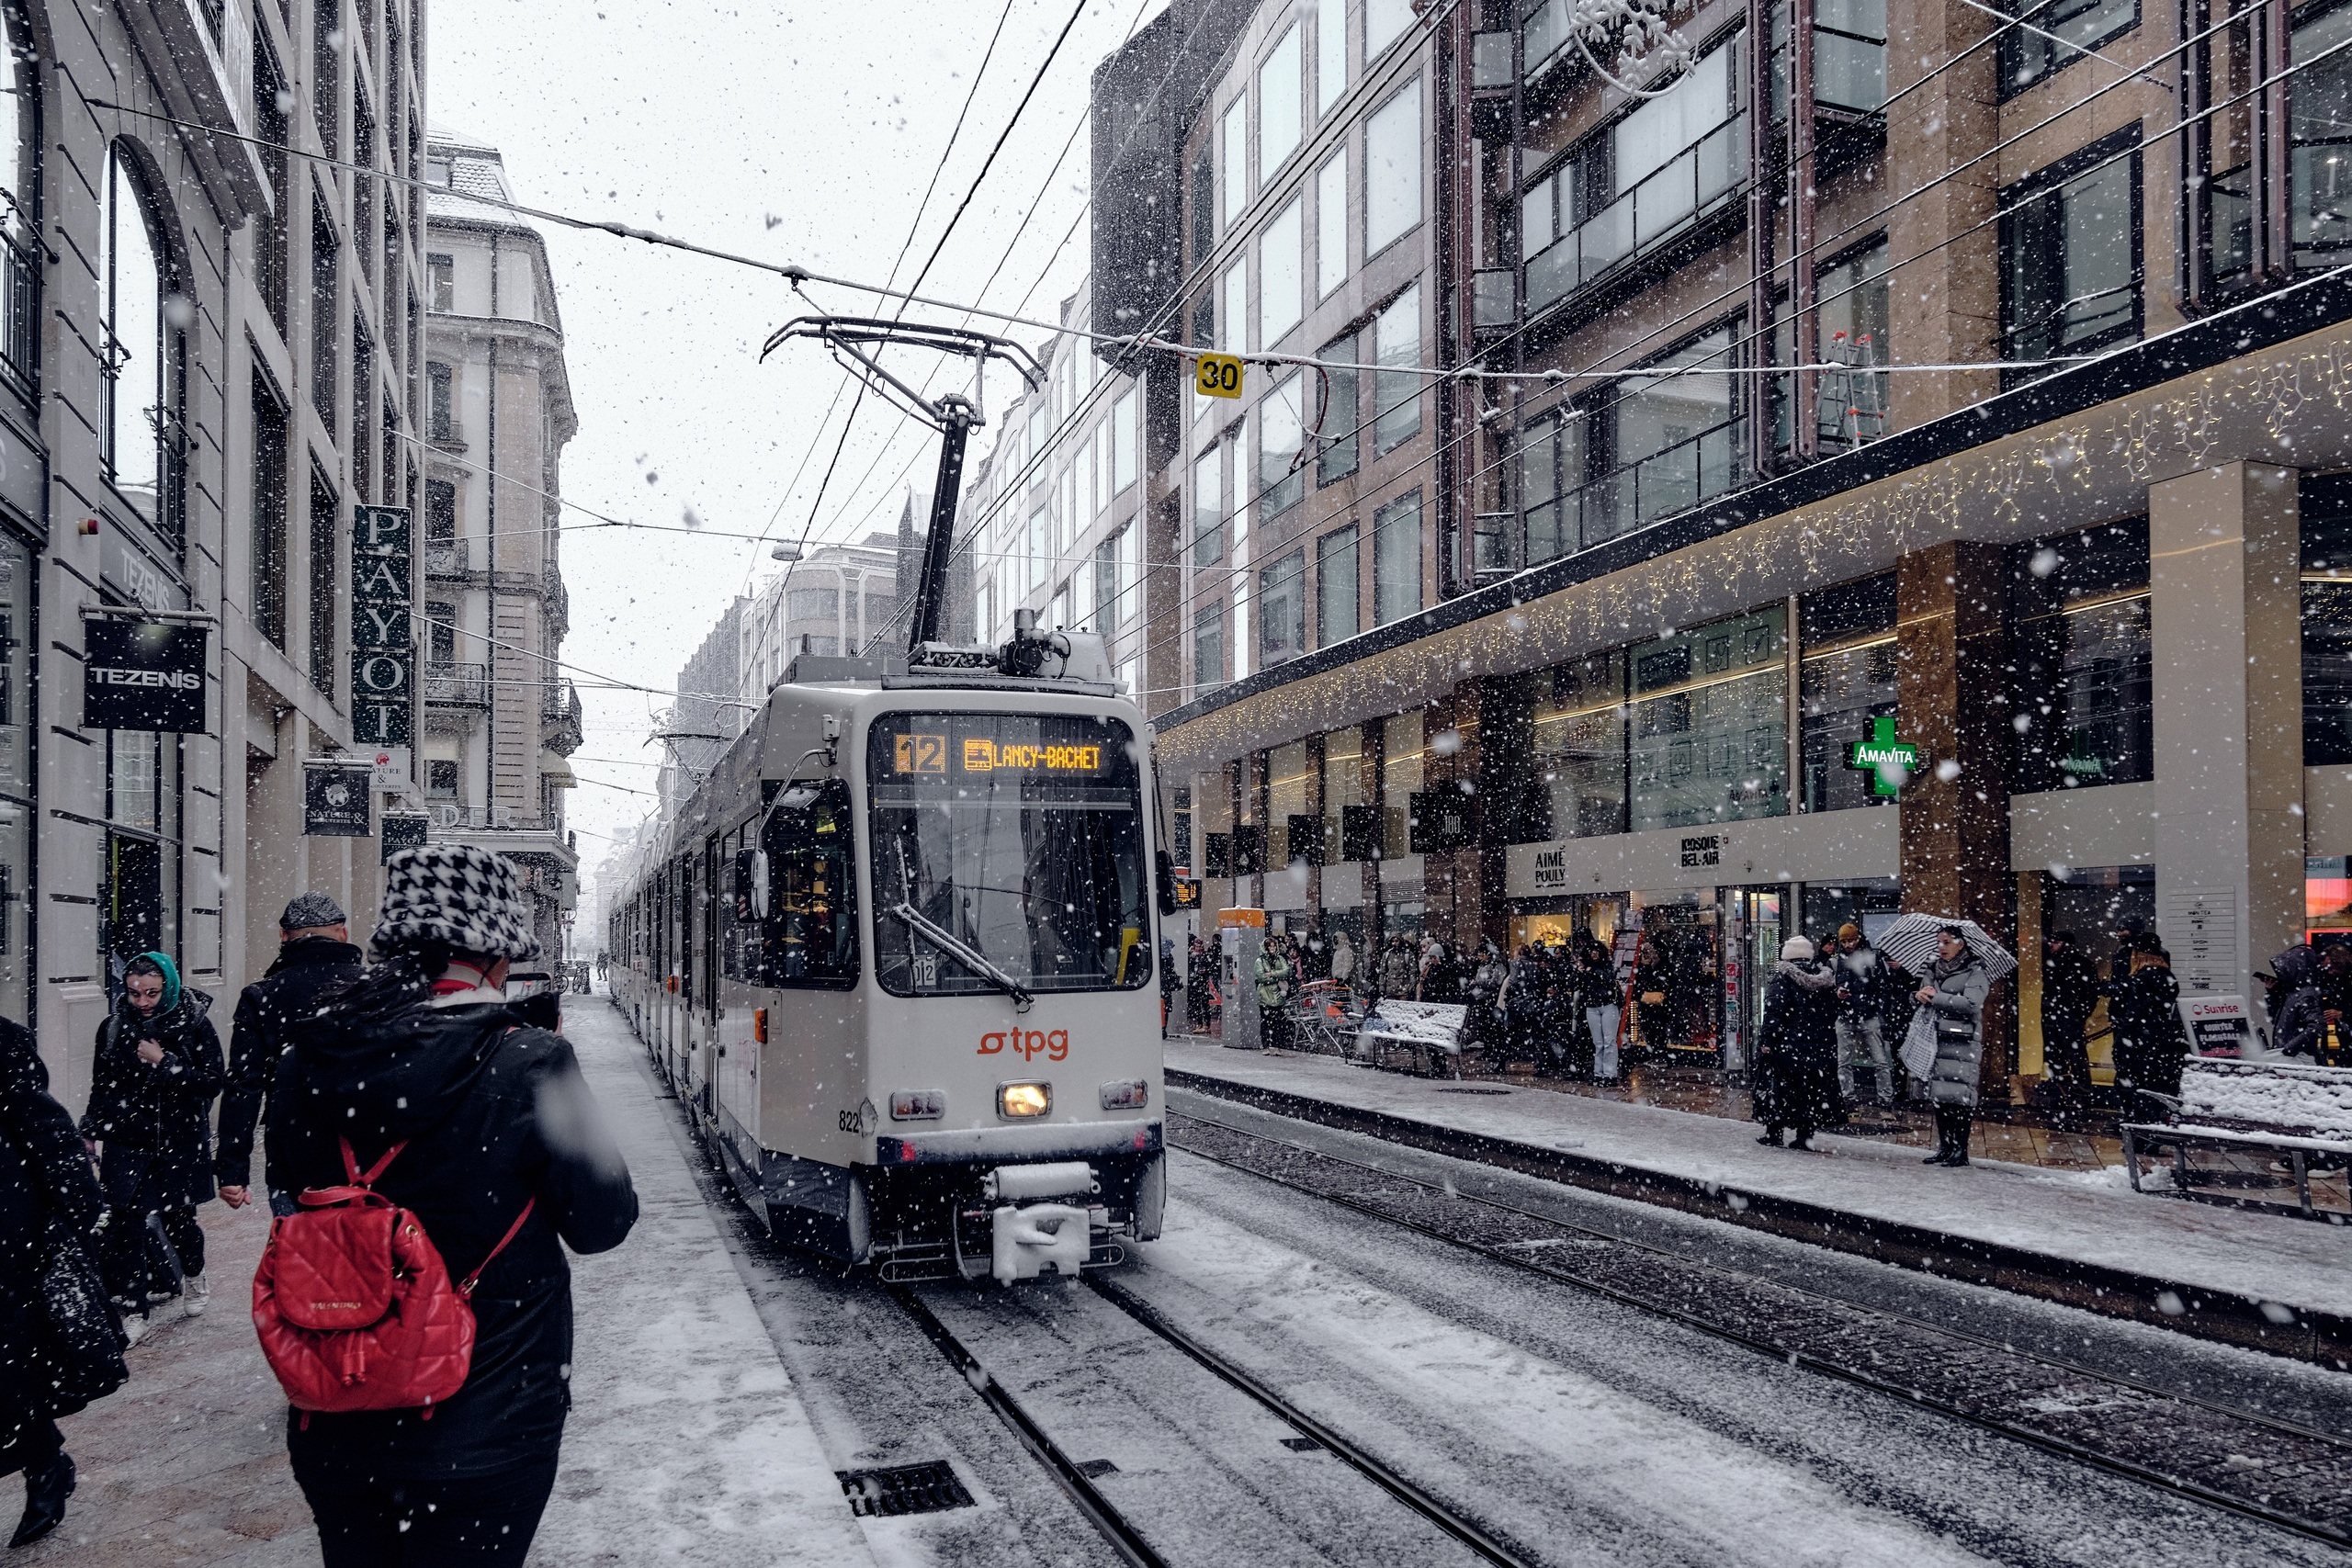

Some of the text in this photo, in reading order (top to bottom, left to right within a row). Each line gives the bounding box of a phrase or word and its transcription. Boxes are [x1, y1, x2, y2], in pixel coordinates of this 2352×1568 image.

[1202, 361, 1238, 391] 30
[361, 512, 404, 739] PAYOT
[900, 736, 941, 772] 12
[993, 744, 1101, 770] LANCY-BACHET
[1857, 745, 1914, 764] AMAVITA
[378, 774, 387, 784] &
[310, 810, 366, 824] NATURE &
[1681, 835, 1719, 852] KIOSQUE
[1535, 845, 1566, 868] AIMÉ
[1535, 868, 1566, 883] POULY
[2203, 1003, 2239, 1014] Sunrise
[2203, 1022, 2234, 1032] WINTER
[839, 1110, 859, 1134] 822
